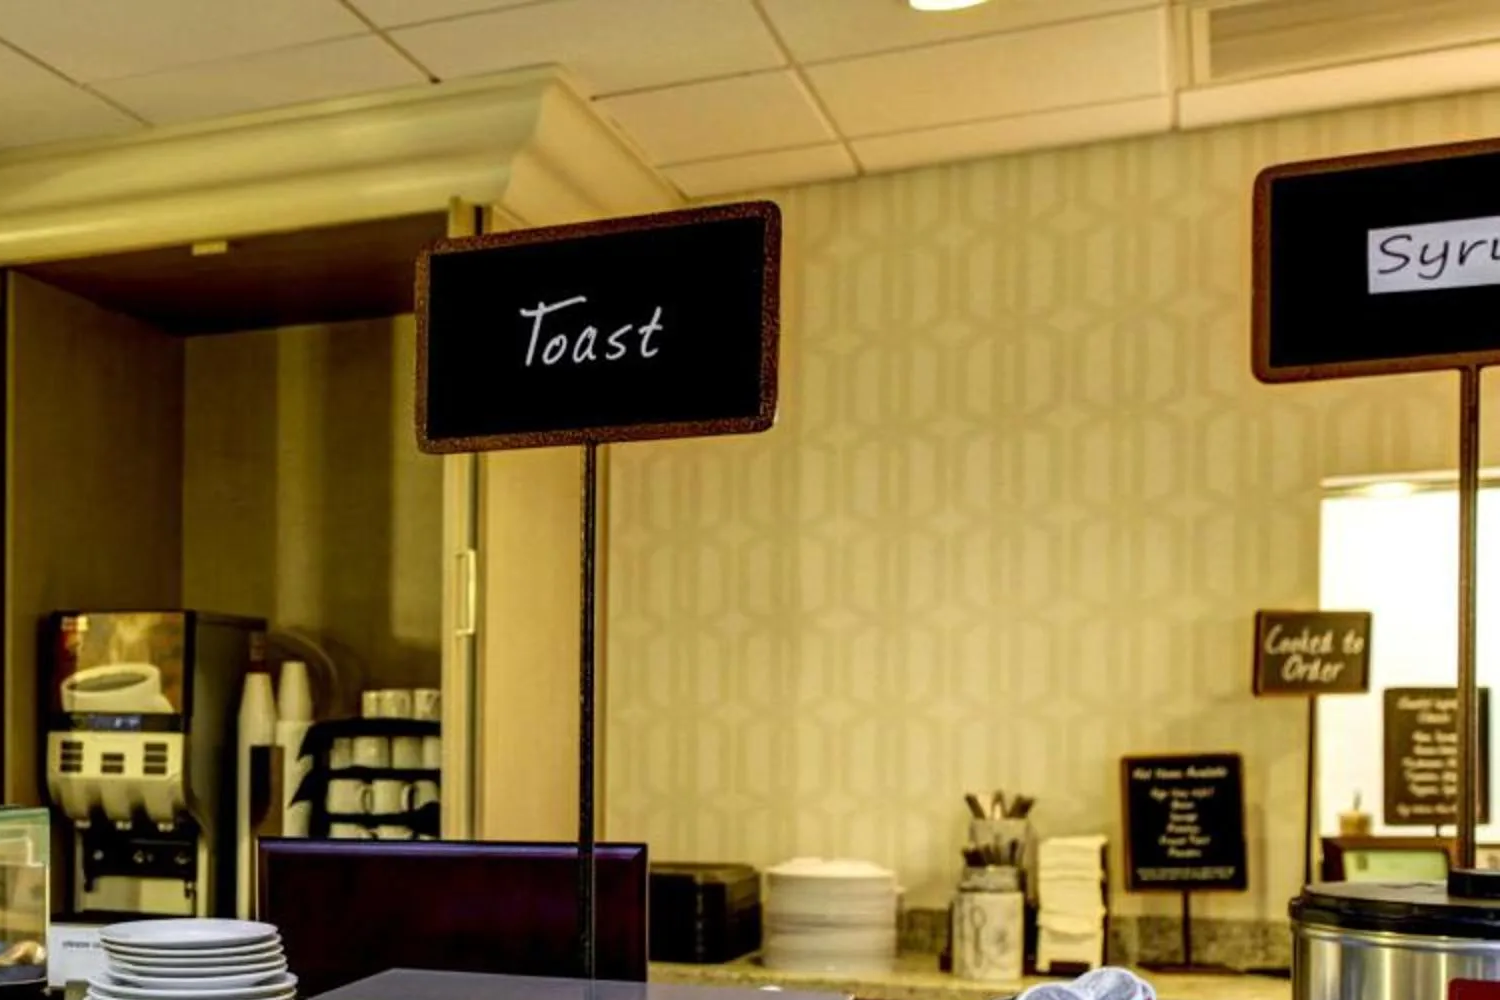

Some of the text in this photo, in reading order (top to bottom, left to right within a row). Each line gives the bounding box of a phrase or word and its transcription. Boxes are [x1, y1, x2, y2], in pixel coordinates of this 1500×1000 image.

[519, 295, 664, 367] Toast
[1265, 624, 1365, 654] Cooked to
[1281, 653, 1344, 682] Order
